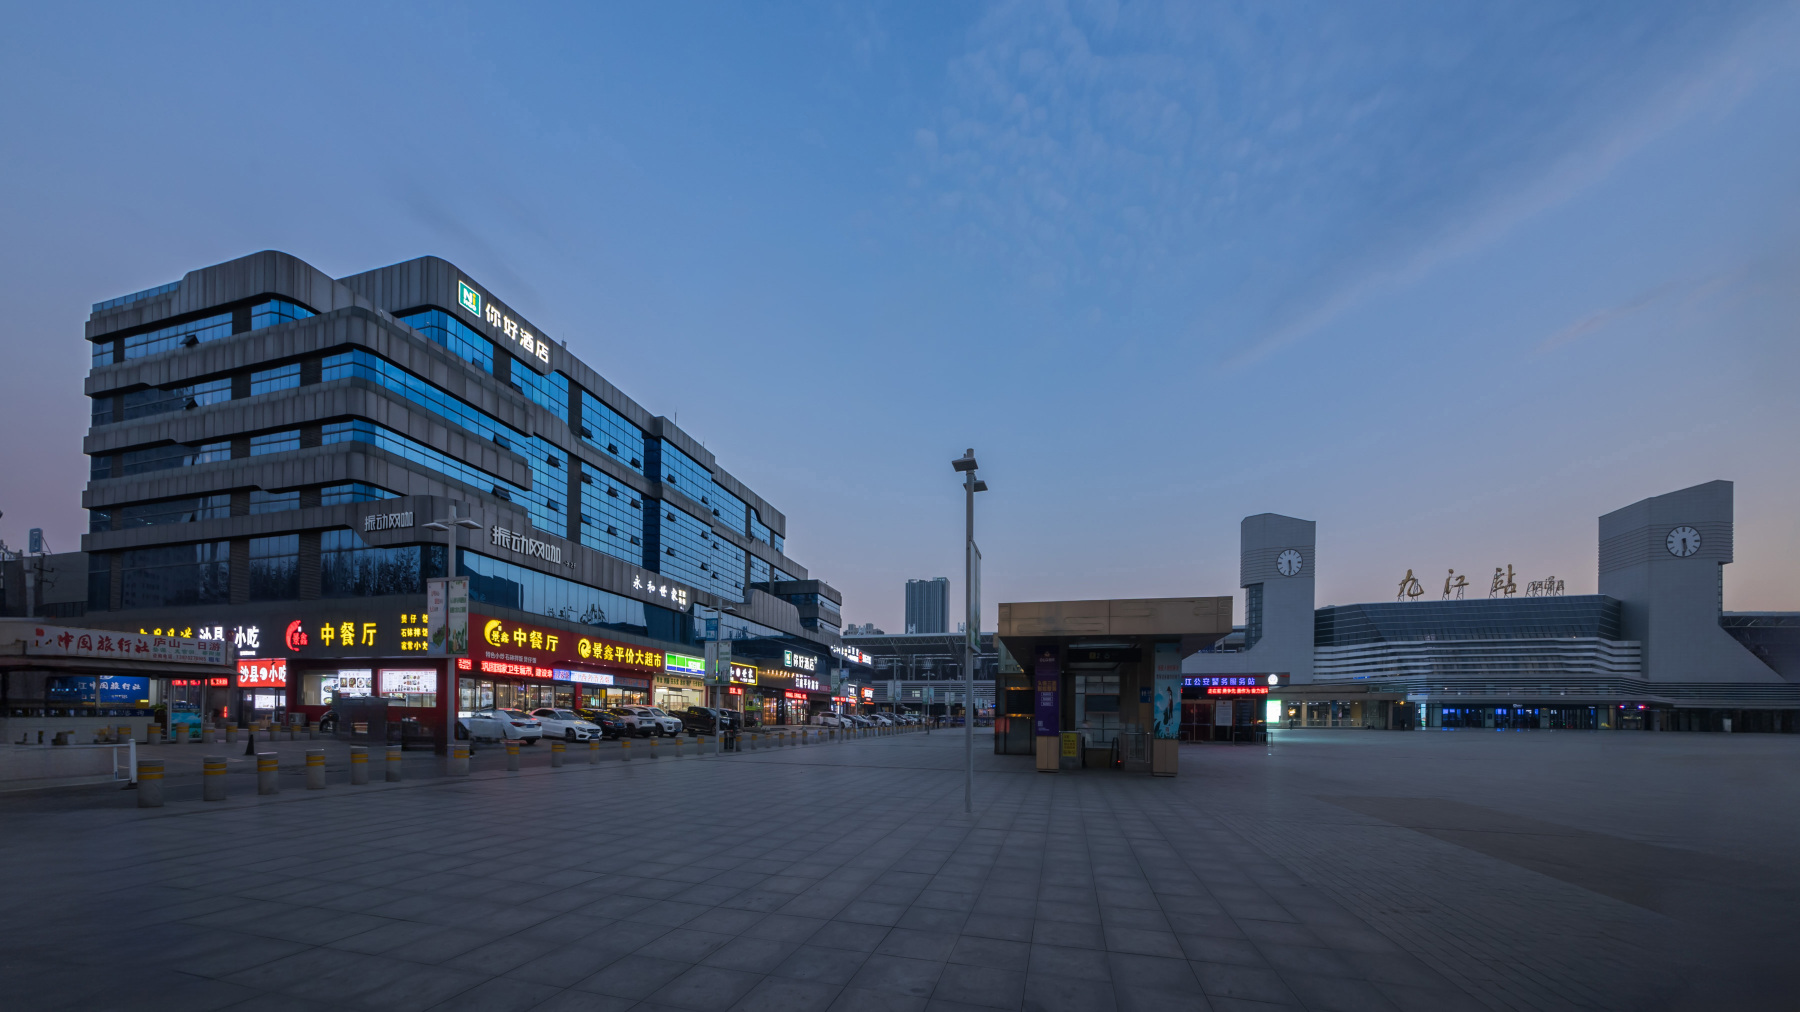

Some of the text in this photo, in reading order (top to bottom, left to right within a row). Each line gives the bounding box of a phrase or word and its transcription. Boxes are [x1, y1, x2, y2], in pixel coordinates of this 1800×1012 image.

[485, 303, 549, 364] 你好酒店
[364, 511, 414, 532] 振动网咖
[492, 524, 562, 564] 振动网咖
[632, 574, 679, 602] 永和世家
[1397, 563, 1516, 597] 九江站
[57, 631, 151, 654] 中国旅行社
[153, 636, 221, 652] 庐山一日游
[234, 625, 260, 649] 小吃
[320, 621, 377, 647] 中餐厅
[513, 627, 559, 656] 中餐厅
[592, 642, 663, 669] 景鑫平价大超市
[239, 665, 259, 683] 沙县
[268, 664, 286, 683] 小吃
[1181, 677, 1256, 686] 江公安警务服务站
